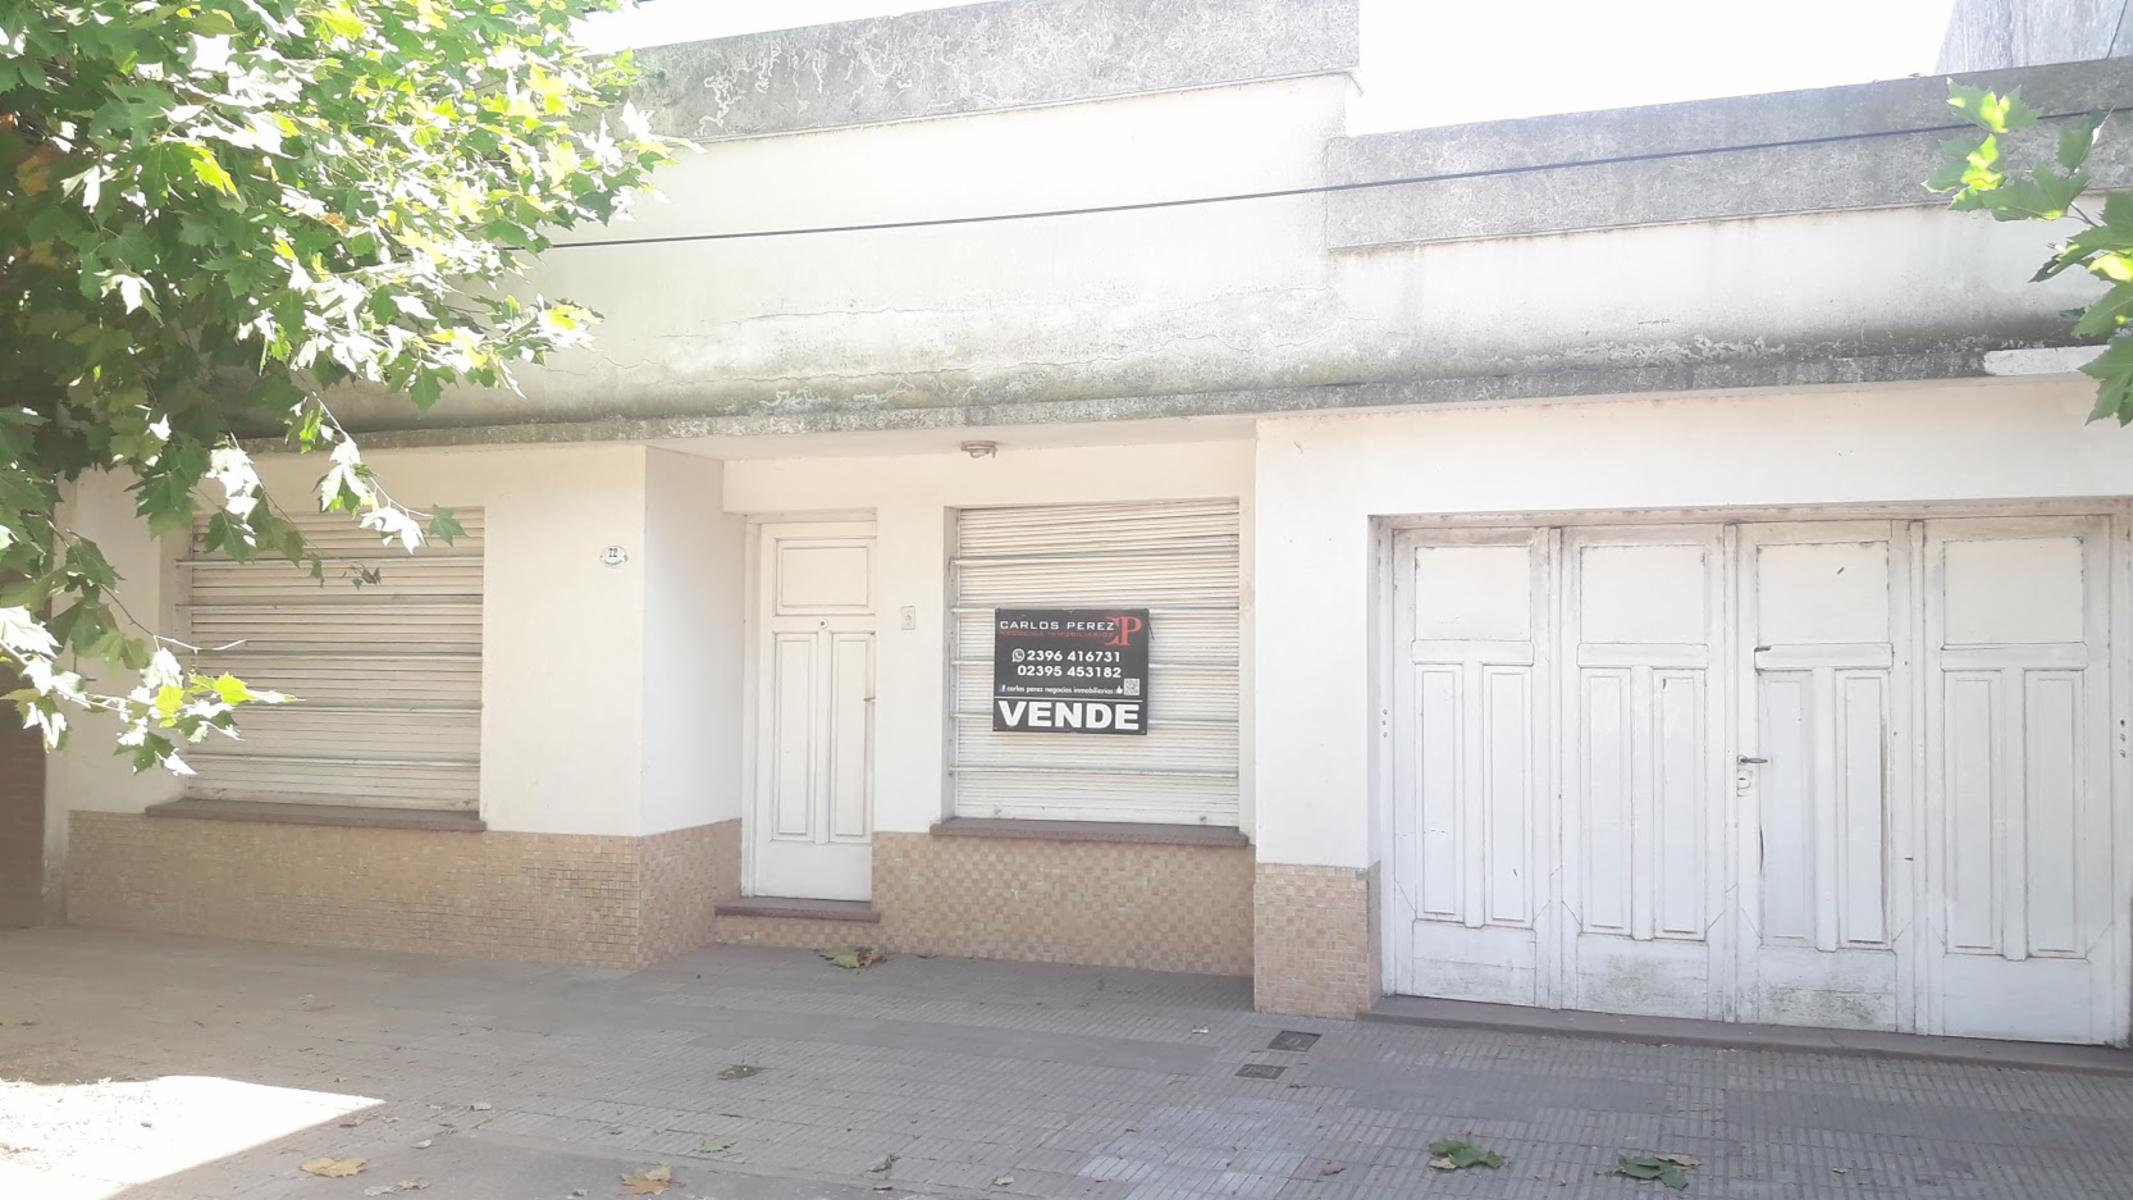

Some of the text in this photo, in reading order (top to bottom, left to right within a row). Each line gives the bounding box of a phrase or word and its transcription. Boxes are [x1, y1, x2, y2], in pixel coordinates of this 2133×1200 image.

[1000, 620, 1115, 631] CARLOS PEREZ
[1027, 650, 1120, 662] 2396 416731
[1017, 665, 1122, 678] 02395 453182
[1026, 686, 1043, 694] perez
[1045, 686, 1072, 694] negocios
[998, 701, 1140, 730] VENDE
